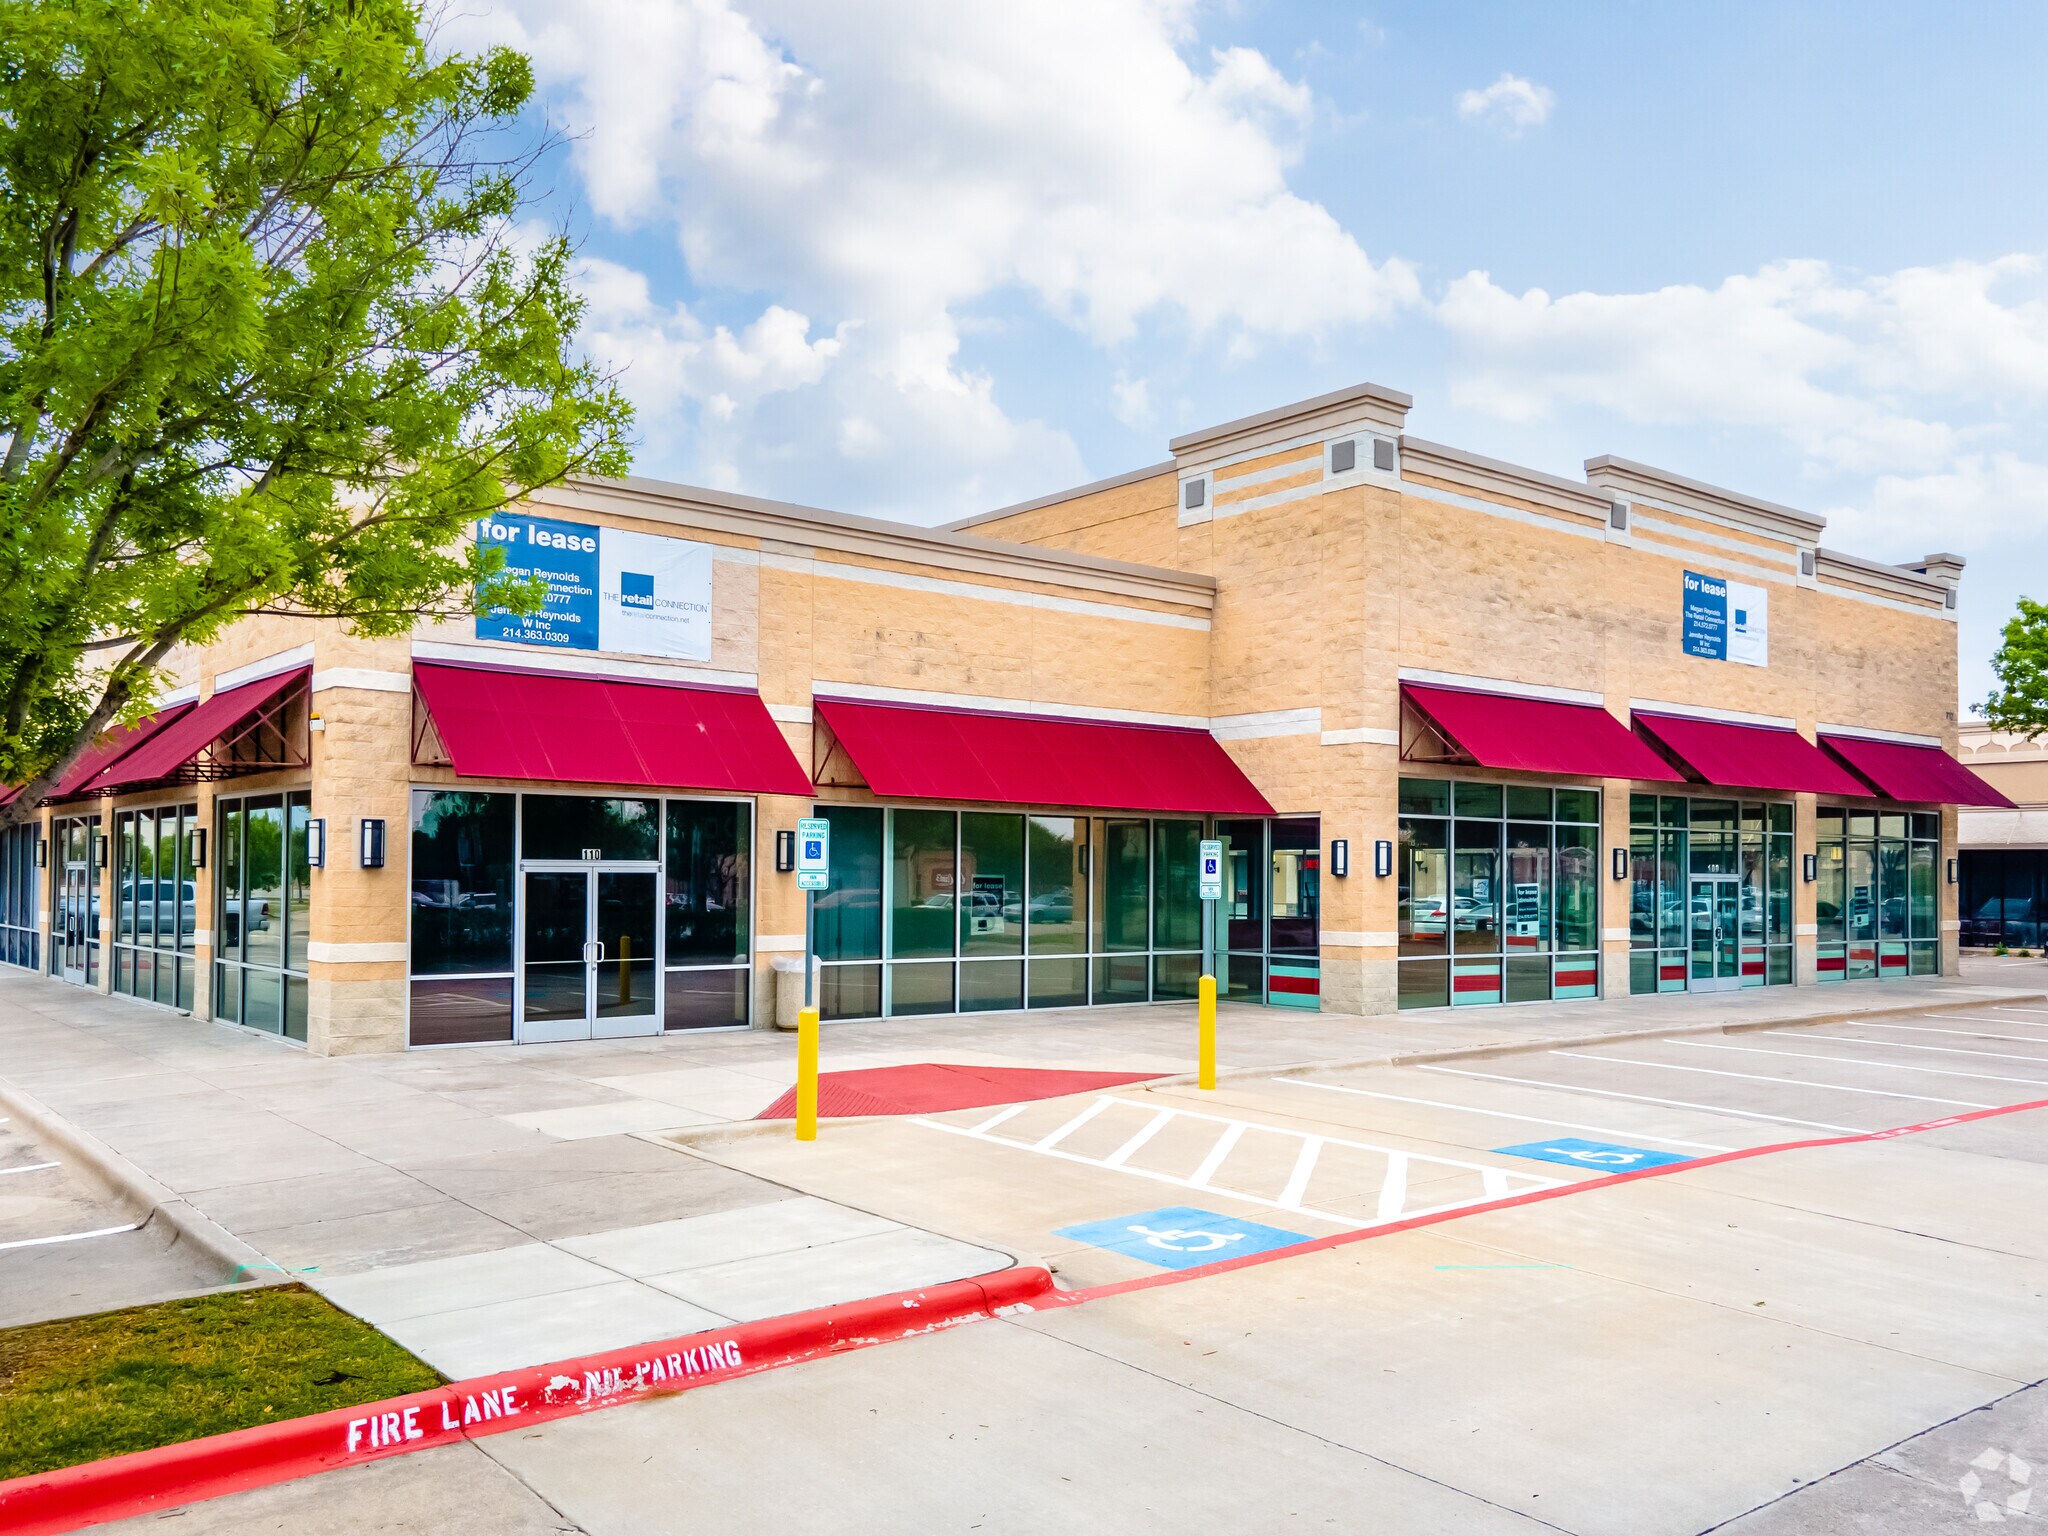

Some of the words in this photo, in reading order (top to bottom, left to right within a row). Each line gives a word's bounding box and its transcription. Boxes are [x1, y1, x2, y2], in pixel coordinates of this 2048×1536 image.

[481, 518, 520, 542] for
[528, 524, 596, 553] lease
[500, 563, 531, 577] egan
[533, 567, 580, 583] Reynolds
[1684, 576, 1699, 591] for
[1701, 580, 1726, 597] lease
[603, 592, 620, 602] THE
[622, 594, 652, 606] retail
[655, 598, 708, 613] CONNECTION
[522, 617, 533, 628] W
[536, 619, 551, 630] Inc
[535, 610, 581, 623] Reynolds
[502, 626, 570, 643] 214.363.0309
[584, 849, 600, 860] 110
[348, 1407, 424, 1452] FIRE
[442, 1386, 520, 1430] LANE
[635, 1340, 742, 1385] PARKING
